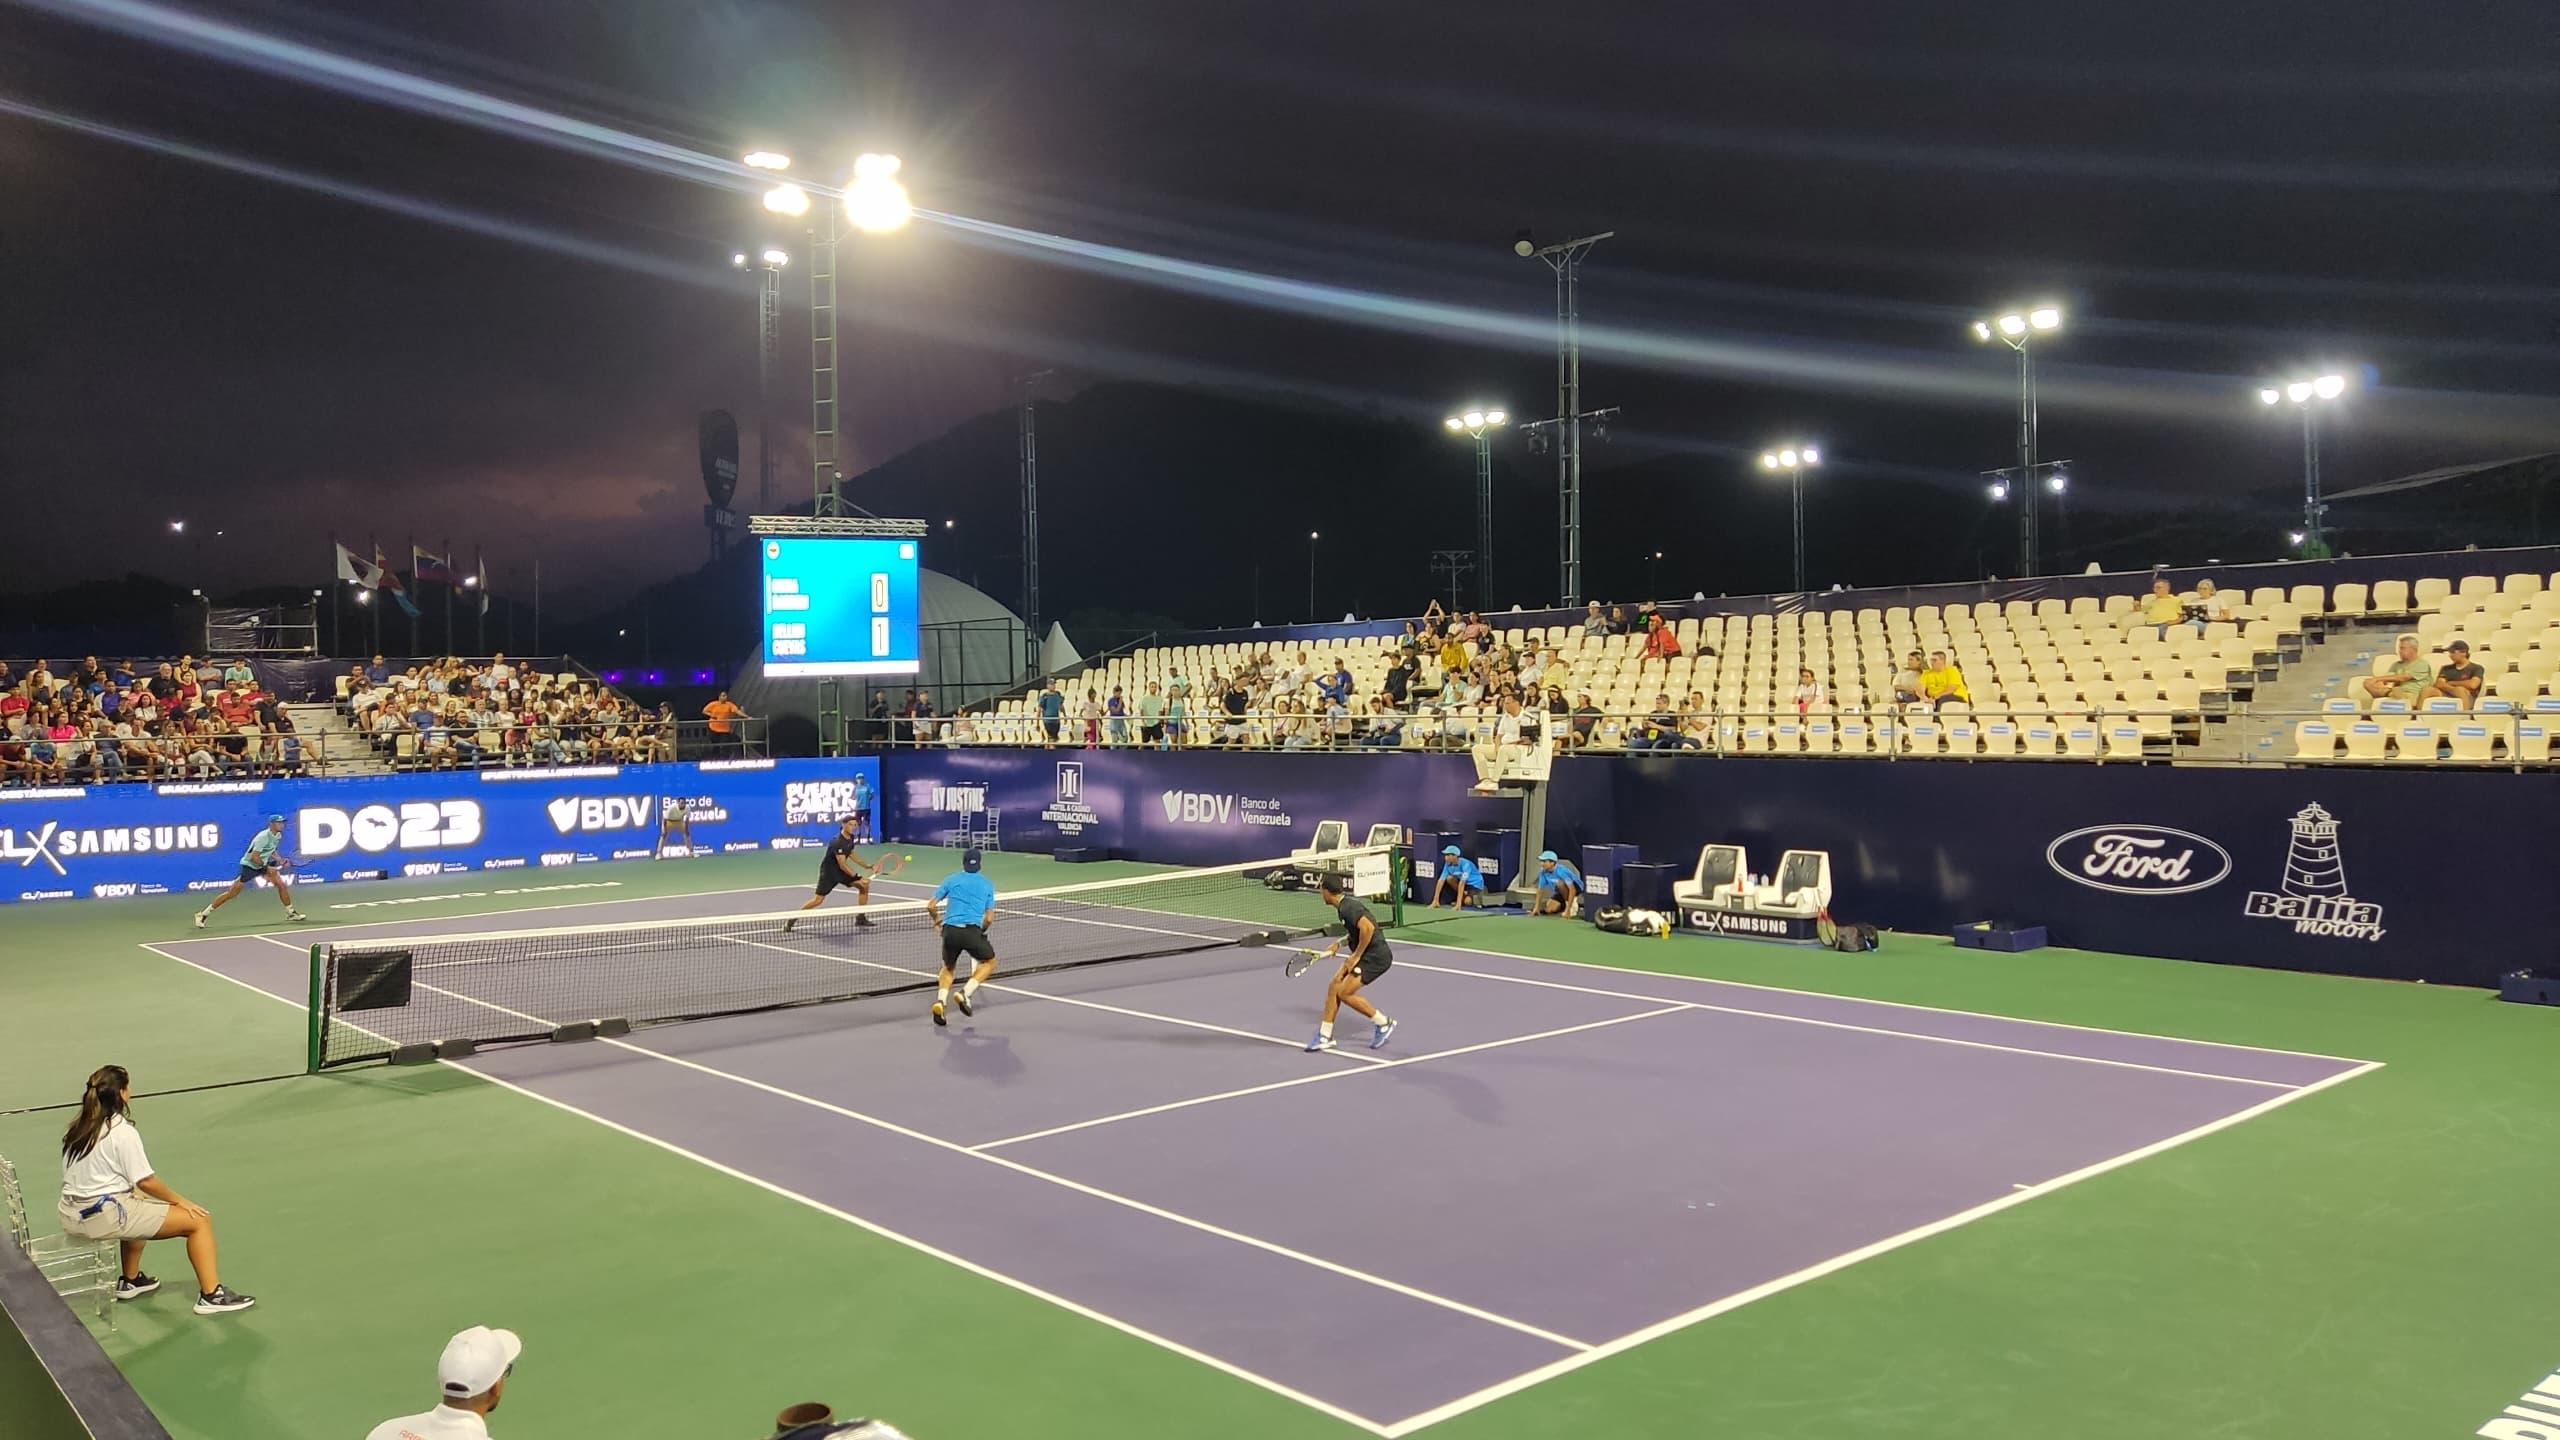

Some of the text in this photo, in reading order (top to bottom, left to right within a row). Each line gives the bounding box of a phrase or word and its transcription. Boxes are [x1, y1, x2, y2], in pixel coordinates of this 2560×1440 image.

[581, 796, 652, 830] BDV
[1183, 793, 1281, 824] BDV Banco de
[1241, 810, 1291, 826] Venezuela
[58, 823, 219, 856] SAMSUNG
[415, 862, 441, 876] BDV
[2083, 834, 2194, 882] Ford
[107, 883, 136, 896] BDV
[1722, 915, 1787, 934] SAMSUNG
[2294, 918, 2387, 942] motors
